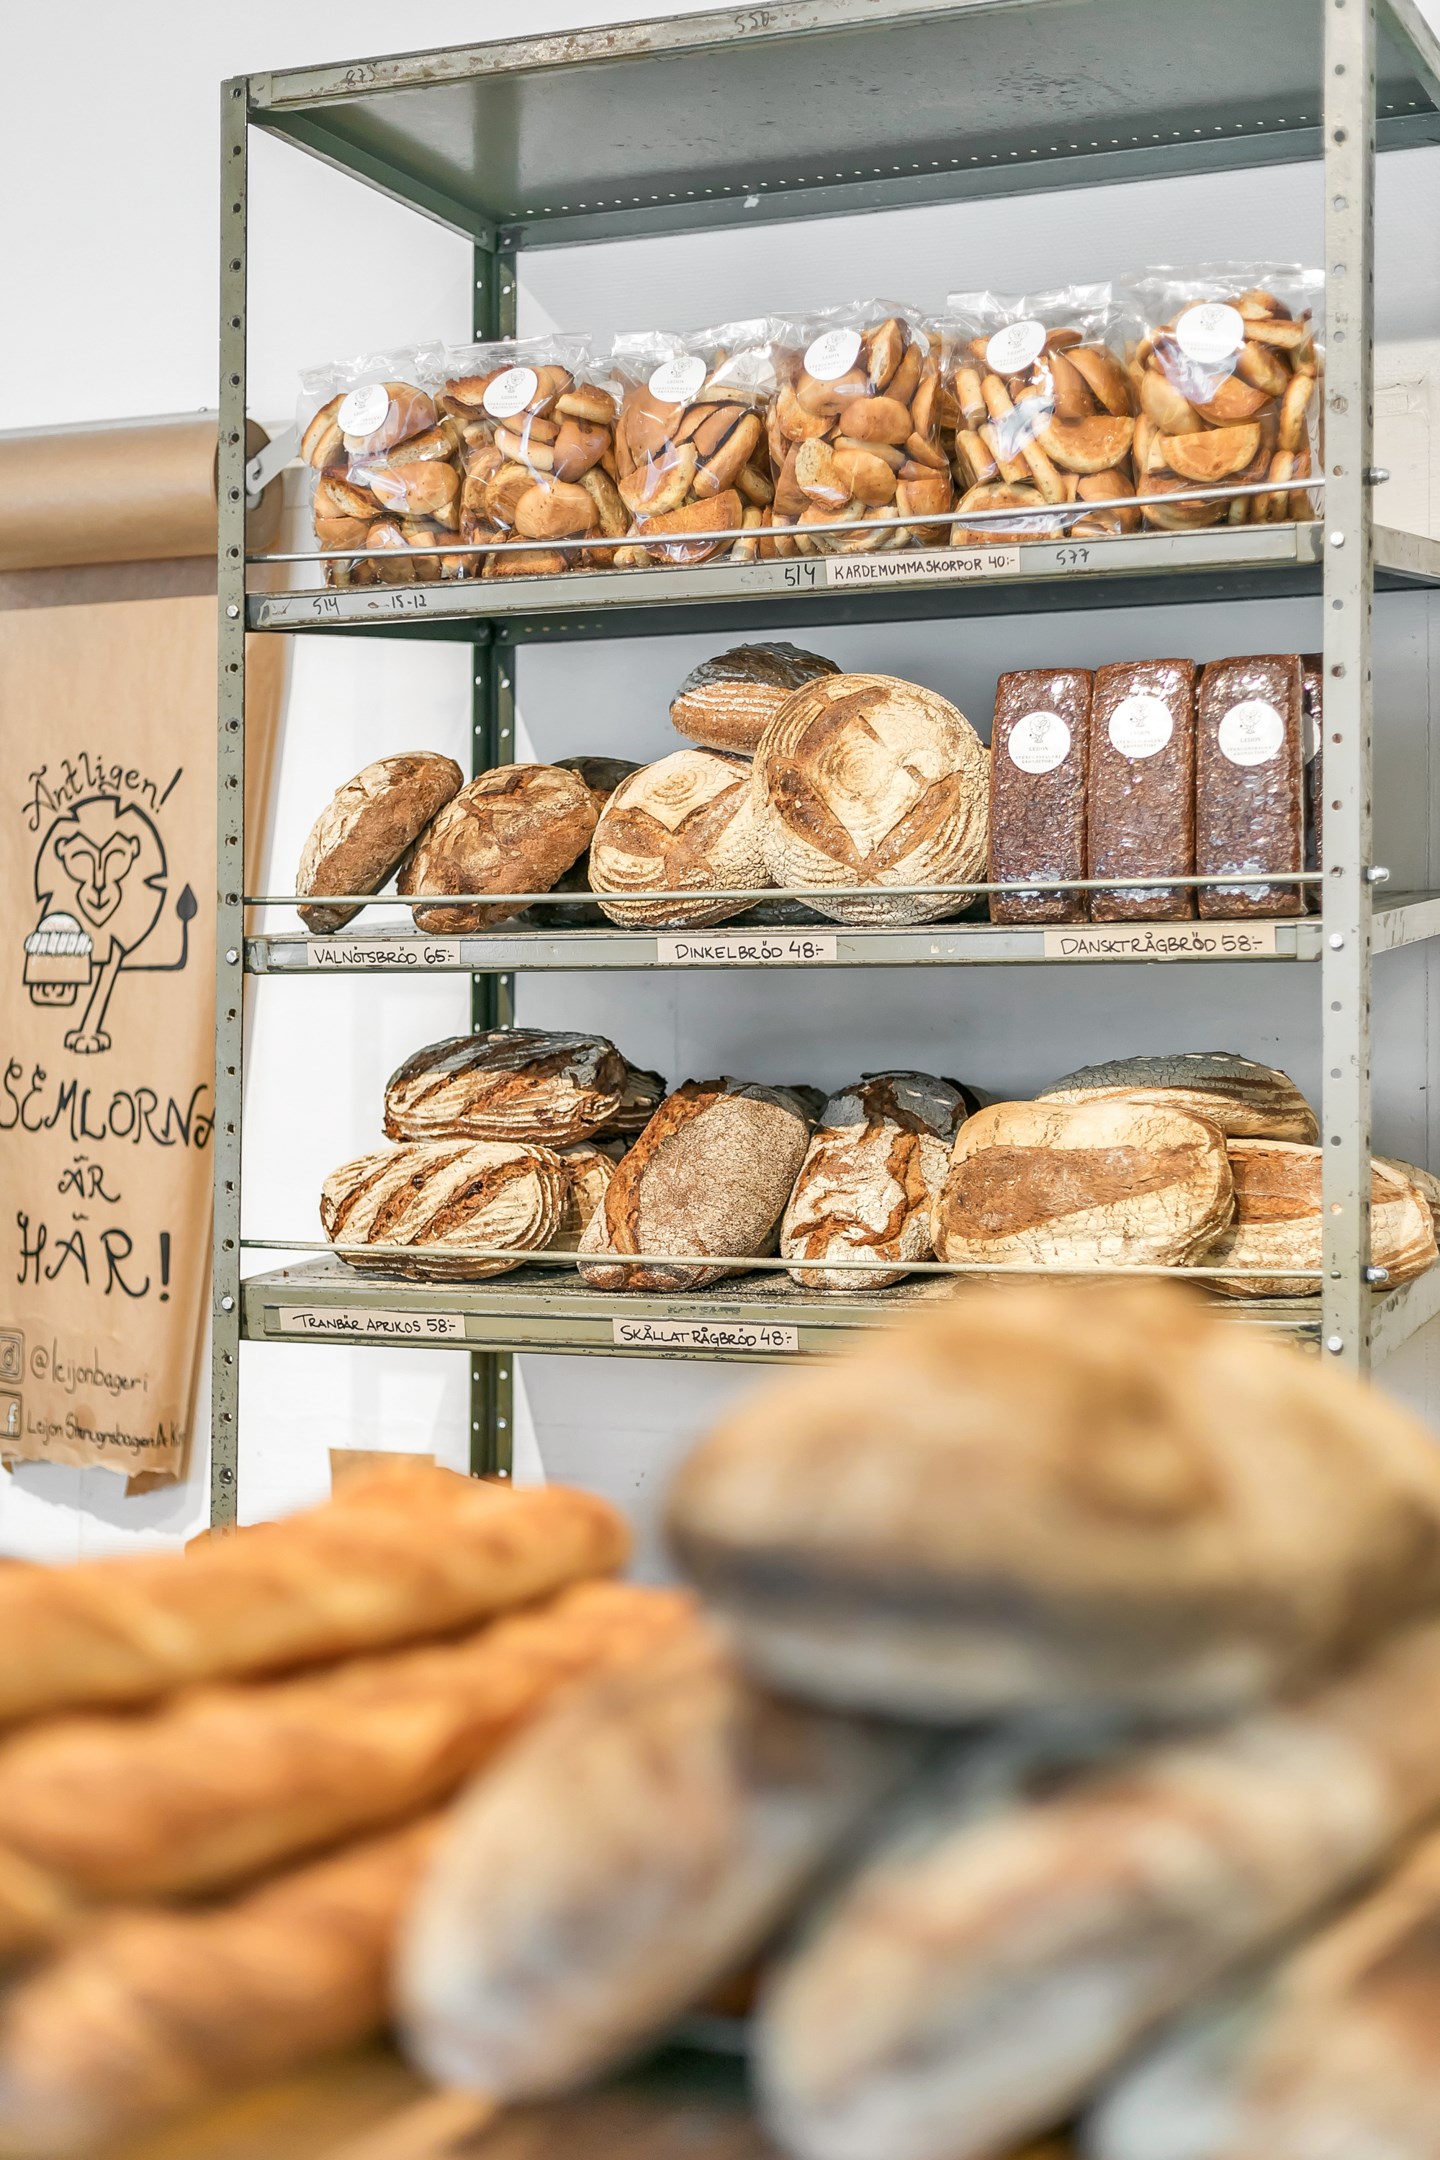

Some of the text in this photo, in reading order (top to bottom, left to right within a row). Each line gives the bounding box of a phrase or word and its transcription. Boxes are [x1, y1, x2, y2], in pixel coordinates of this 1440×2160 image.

[834, 554, 1016, 580] KARDEMUMMASKORPOR 40:-
[675, 940, 824, 960] DINKELBRÖD 48:-
[1060, 931, 1263, 955] DANSKTRÅGBRÖD 58:-
[423, 947, 455, 964] 65:-
[57, 1154, 121, 1203] ÄR
[366, 1318, 421, 1334] APRIKOS
[426, 1318, 456, 1332] 58:-
[760, 1327, 793, 1346] 48:-
